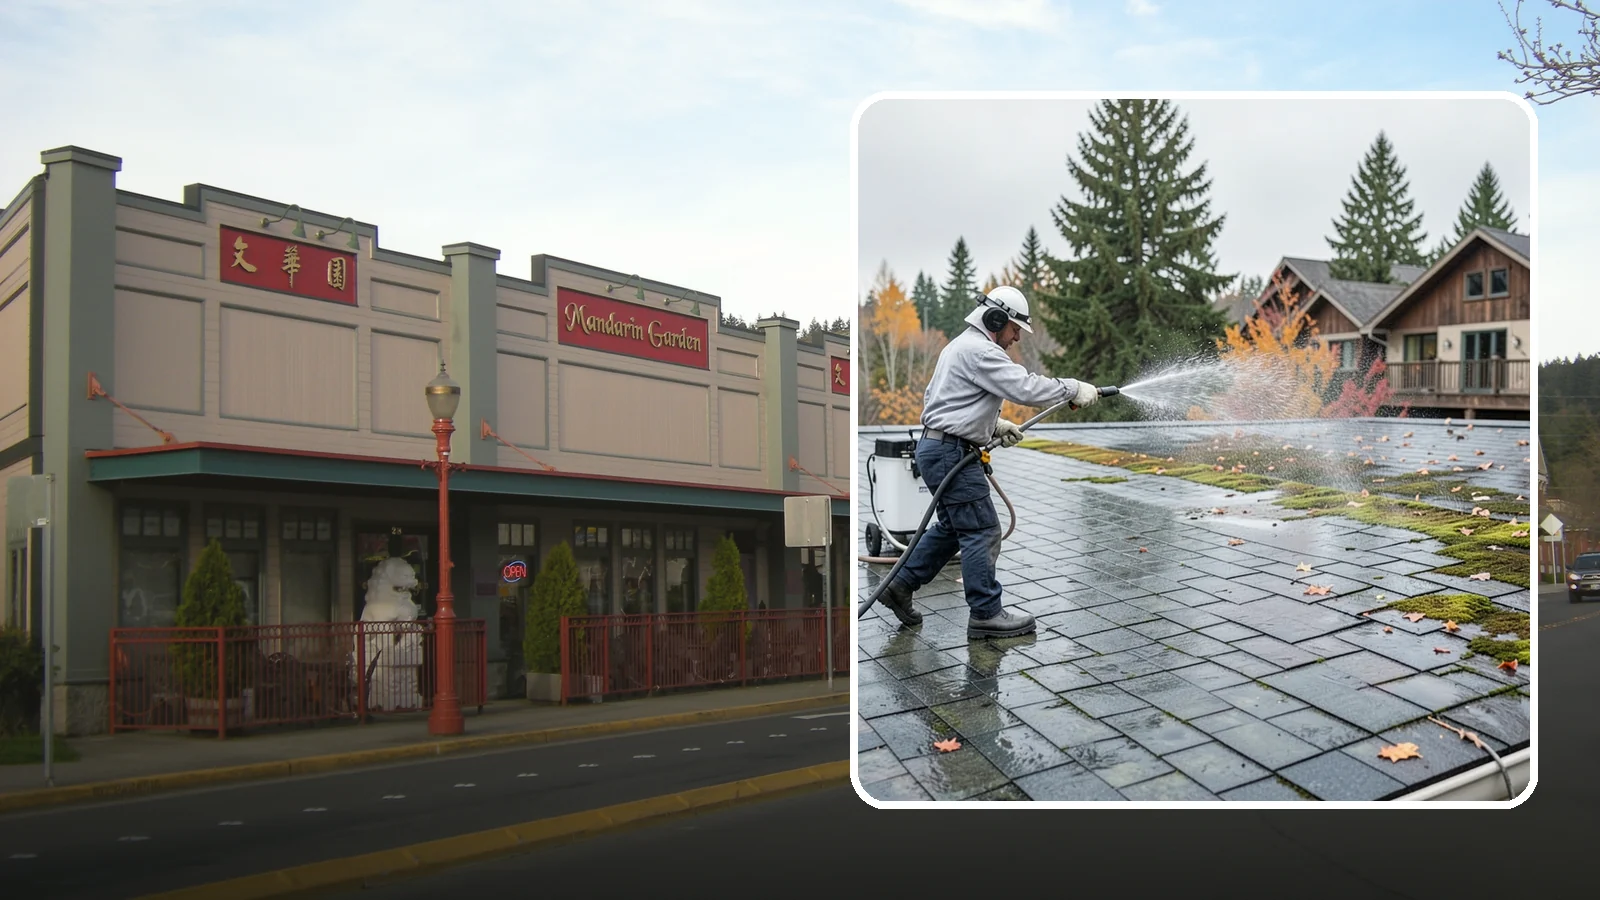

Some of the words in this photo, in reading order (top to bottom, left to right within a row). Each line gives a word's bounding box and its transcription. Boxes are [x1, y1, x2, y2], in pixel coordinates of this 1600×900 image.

[231, 235, 346, 290] 文華園
[564, 302, 644, 341] Mandarin
[647, 320, 702, 352] Garden
[503, 565, 527, 578] OPEN
